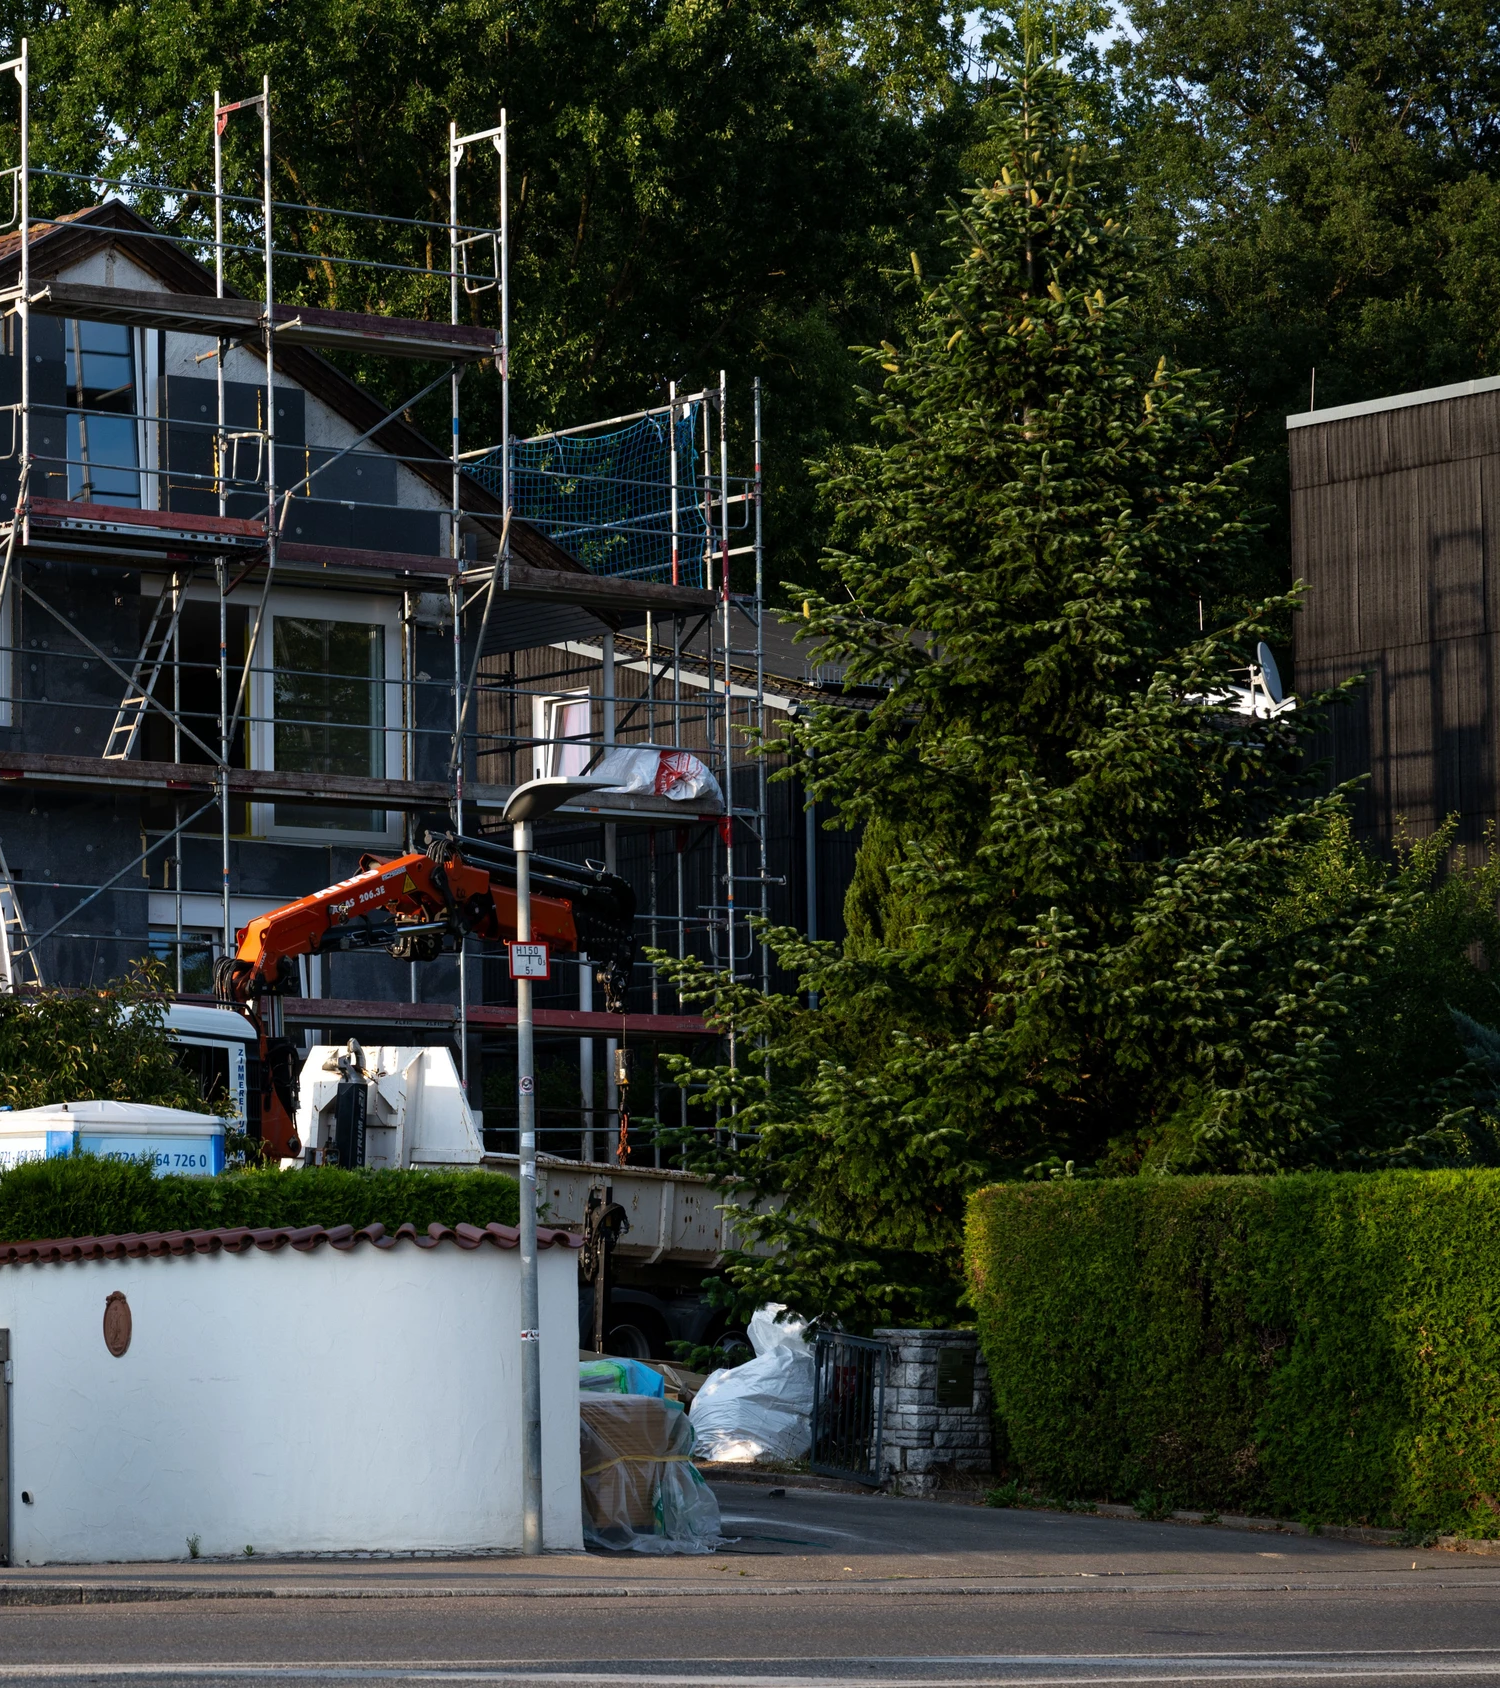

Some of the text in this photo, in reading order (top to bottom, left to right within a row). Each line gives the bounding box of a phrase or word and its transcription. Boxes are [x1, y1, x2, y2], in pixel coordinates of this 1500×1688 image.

[359, 885, 386, 904] 206.3E
[356, 1120, 364, 1166] CTRUM
[174, 1154, 196, 1167] 726
[199, 1154, 207, 1167] 0
